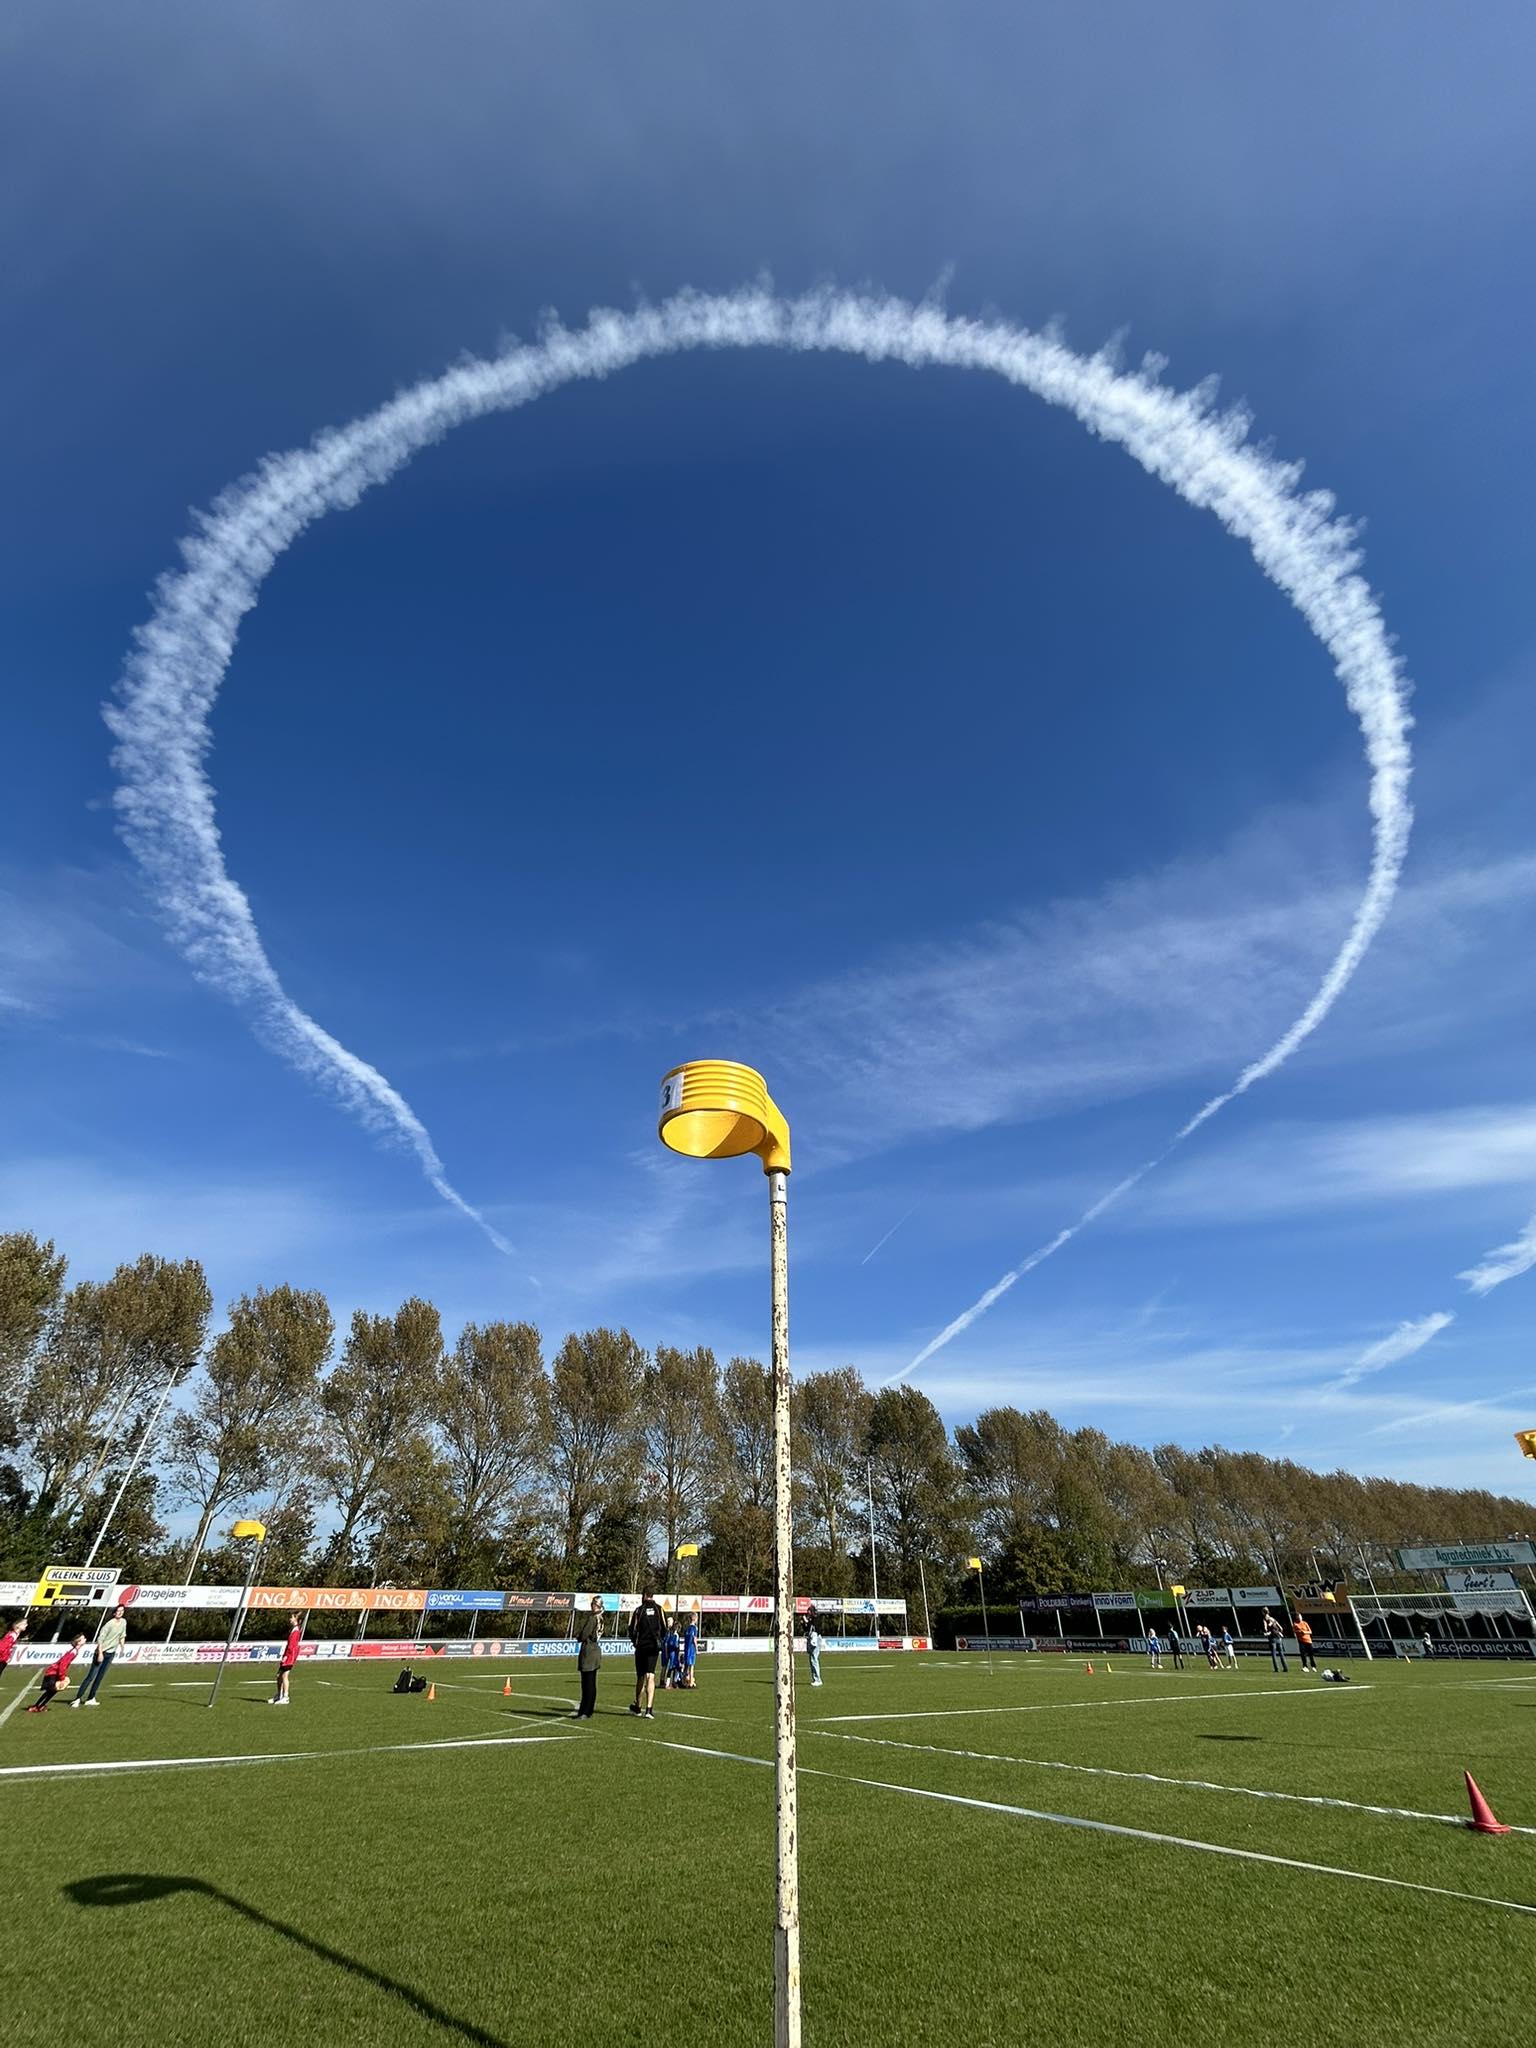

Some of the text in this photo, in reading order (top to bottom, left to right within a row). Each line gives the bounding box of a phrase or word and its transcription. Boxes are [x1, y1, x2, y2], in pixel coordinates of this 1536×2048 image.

[662, 1085, 671, 1108] 3
[1435, 1545, 1492, 1564] Agrotechniek
[51, 1571, 112, 1581] KLEINE SLUIS
[252, 1592, 404, 1607] ING ING ING
[532, 1642, 577, 1654] SENSSON
